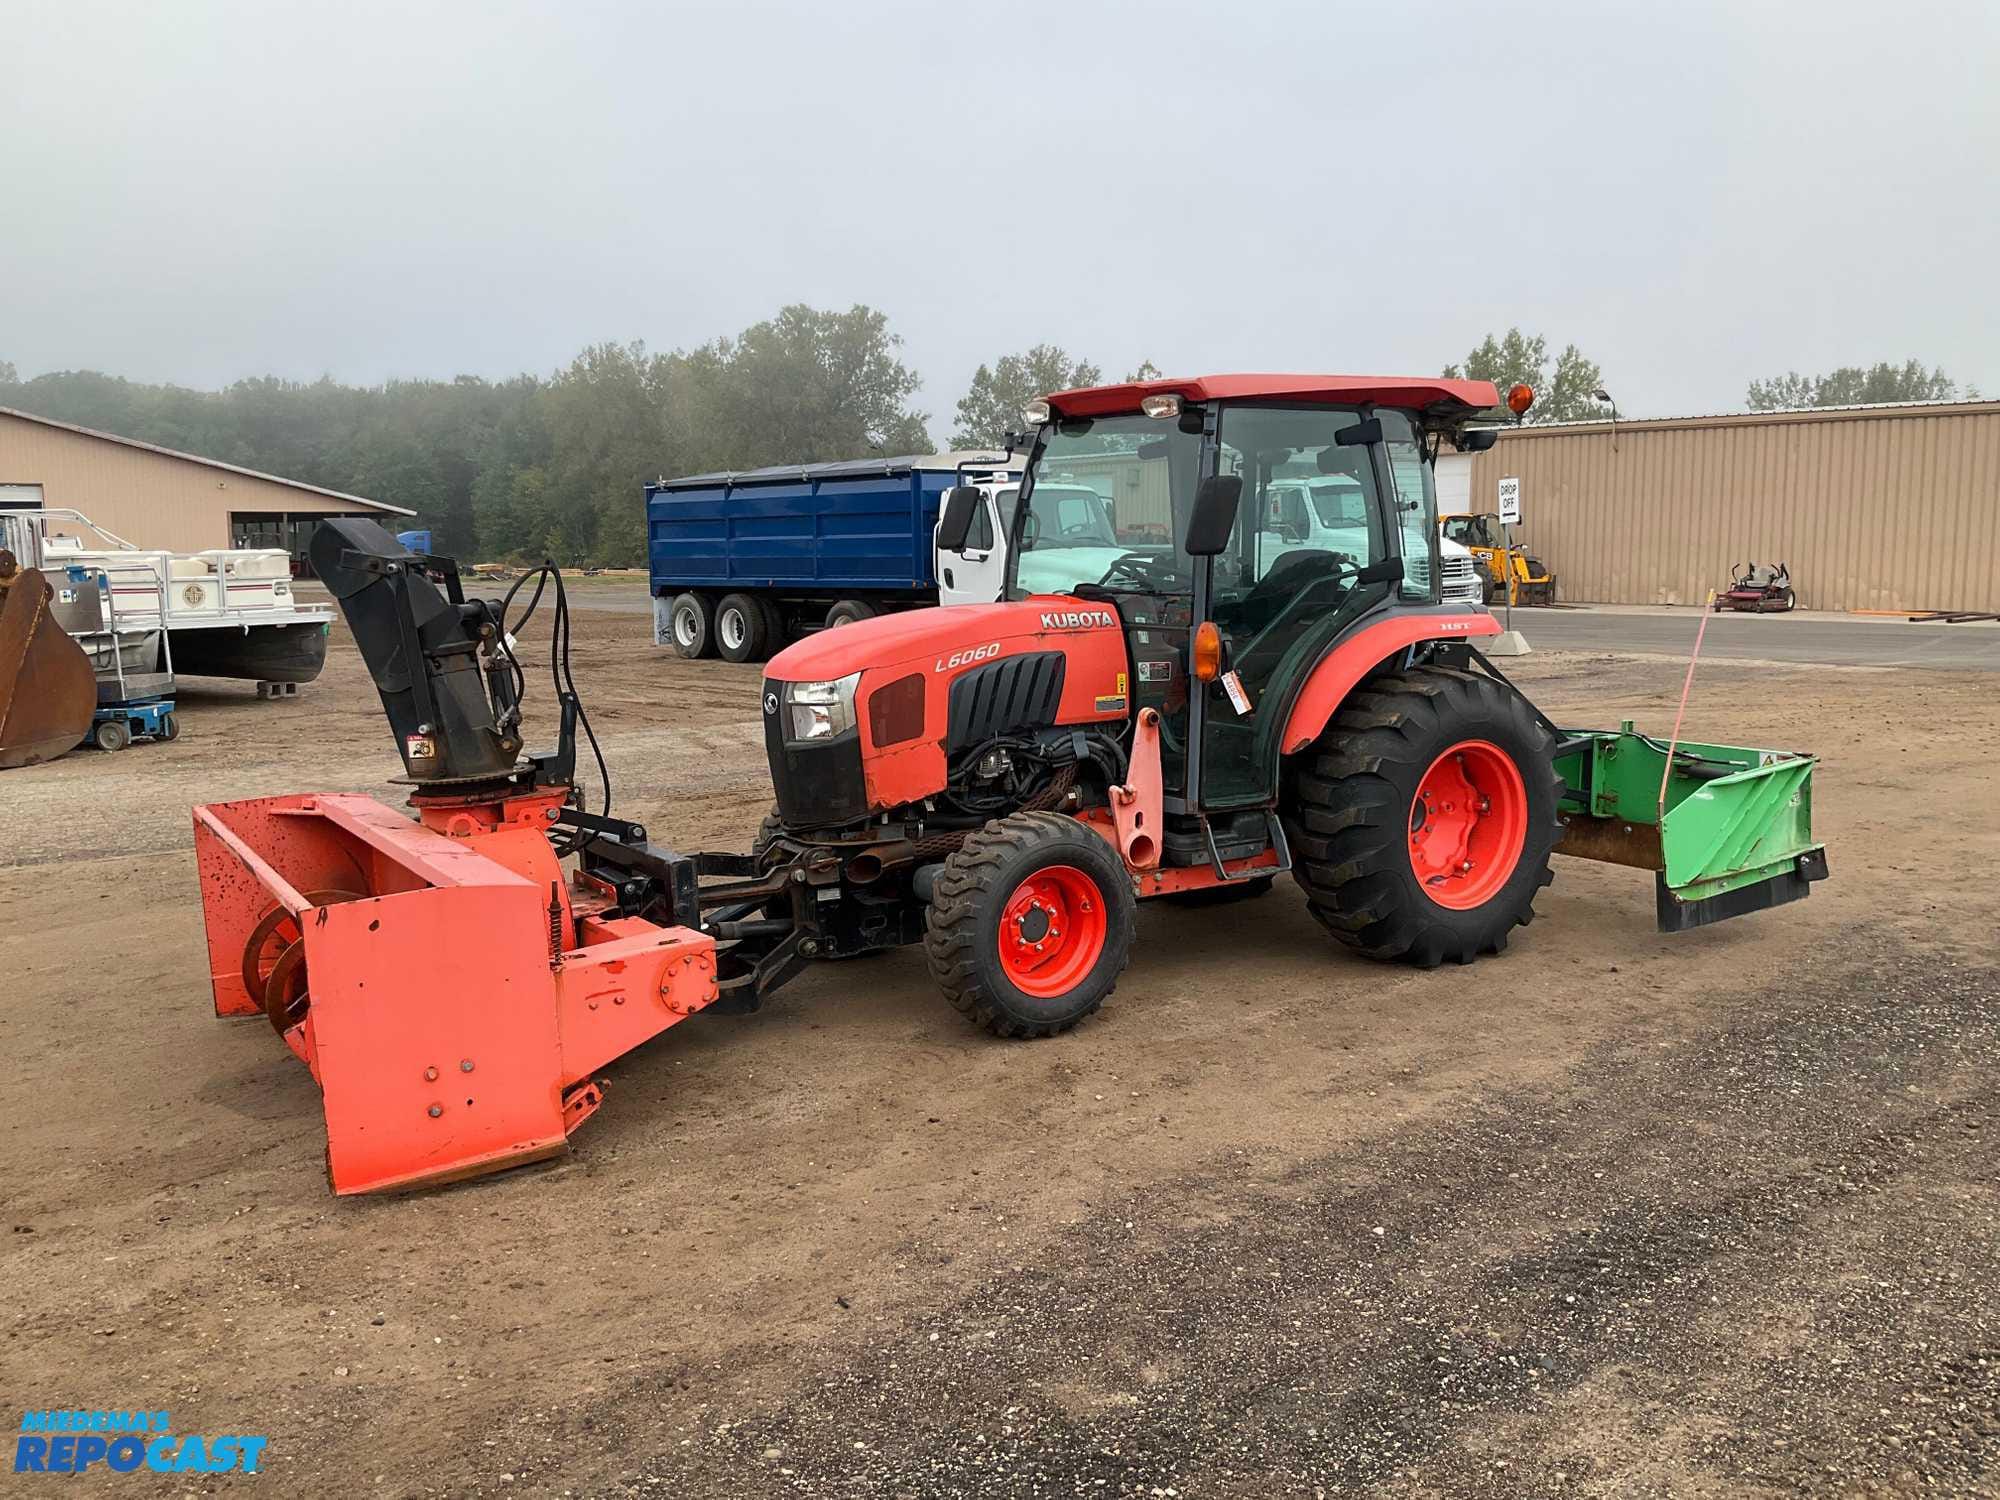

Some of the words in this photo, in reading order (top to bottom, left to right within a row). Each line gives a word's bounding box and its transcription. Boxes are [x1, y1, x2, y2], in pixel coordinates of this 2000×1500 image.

[1500, 484, 1516, 495] DROP
[1503, 497, 1514, 508] OFF
[1040, 612, 1115, 629] KUBOTA
[934, 643, 1001, 673] L6060
